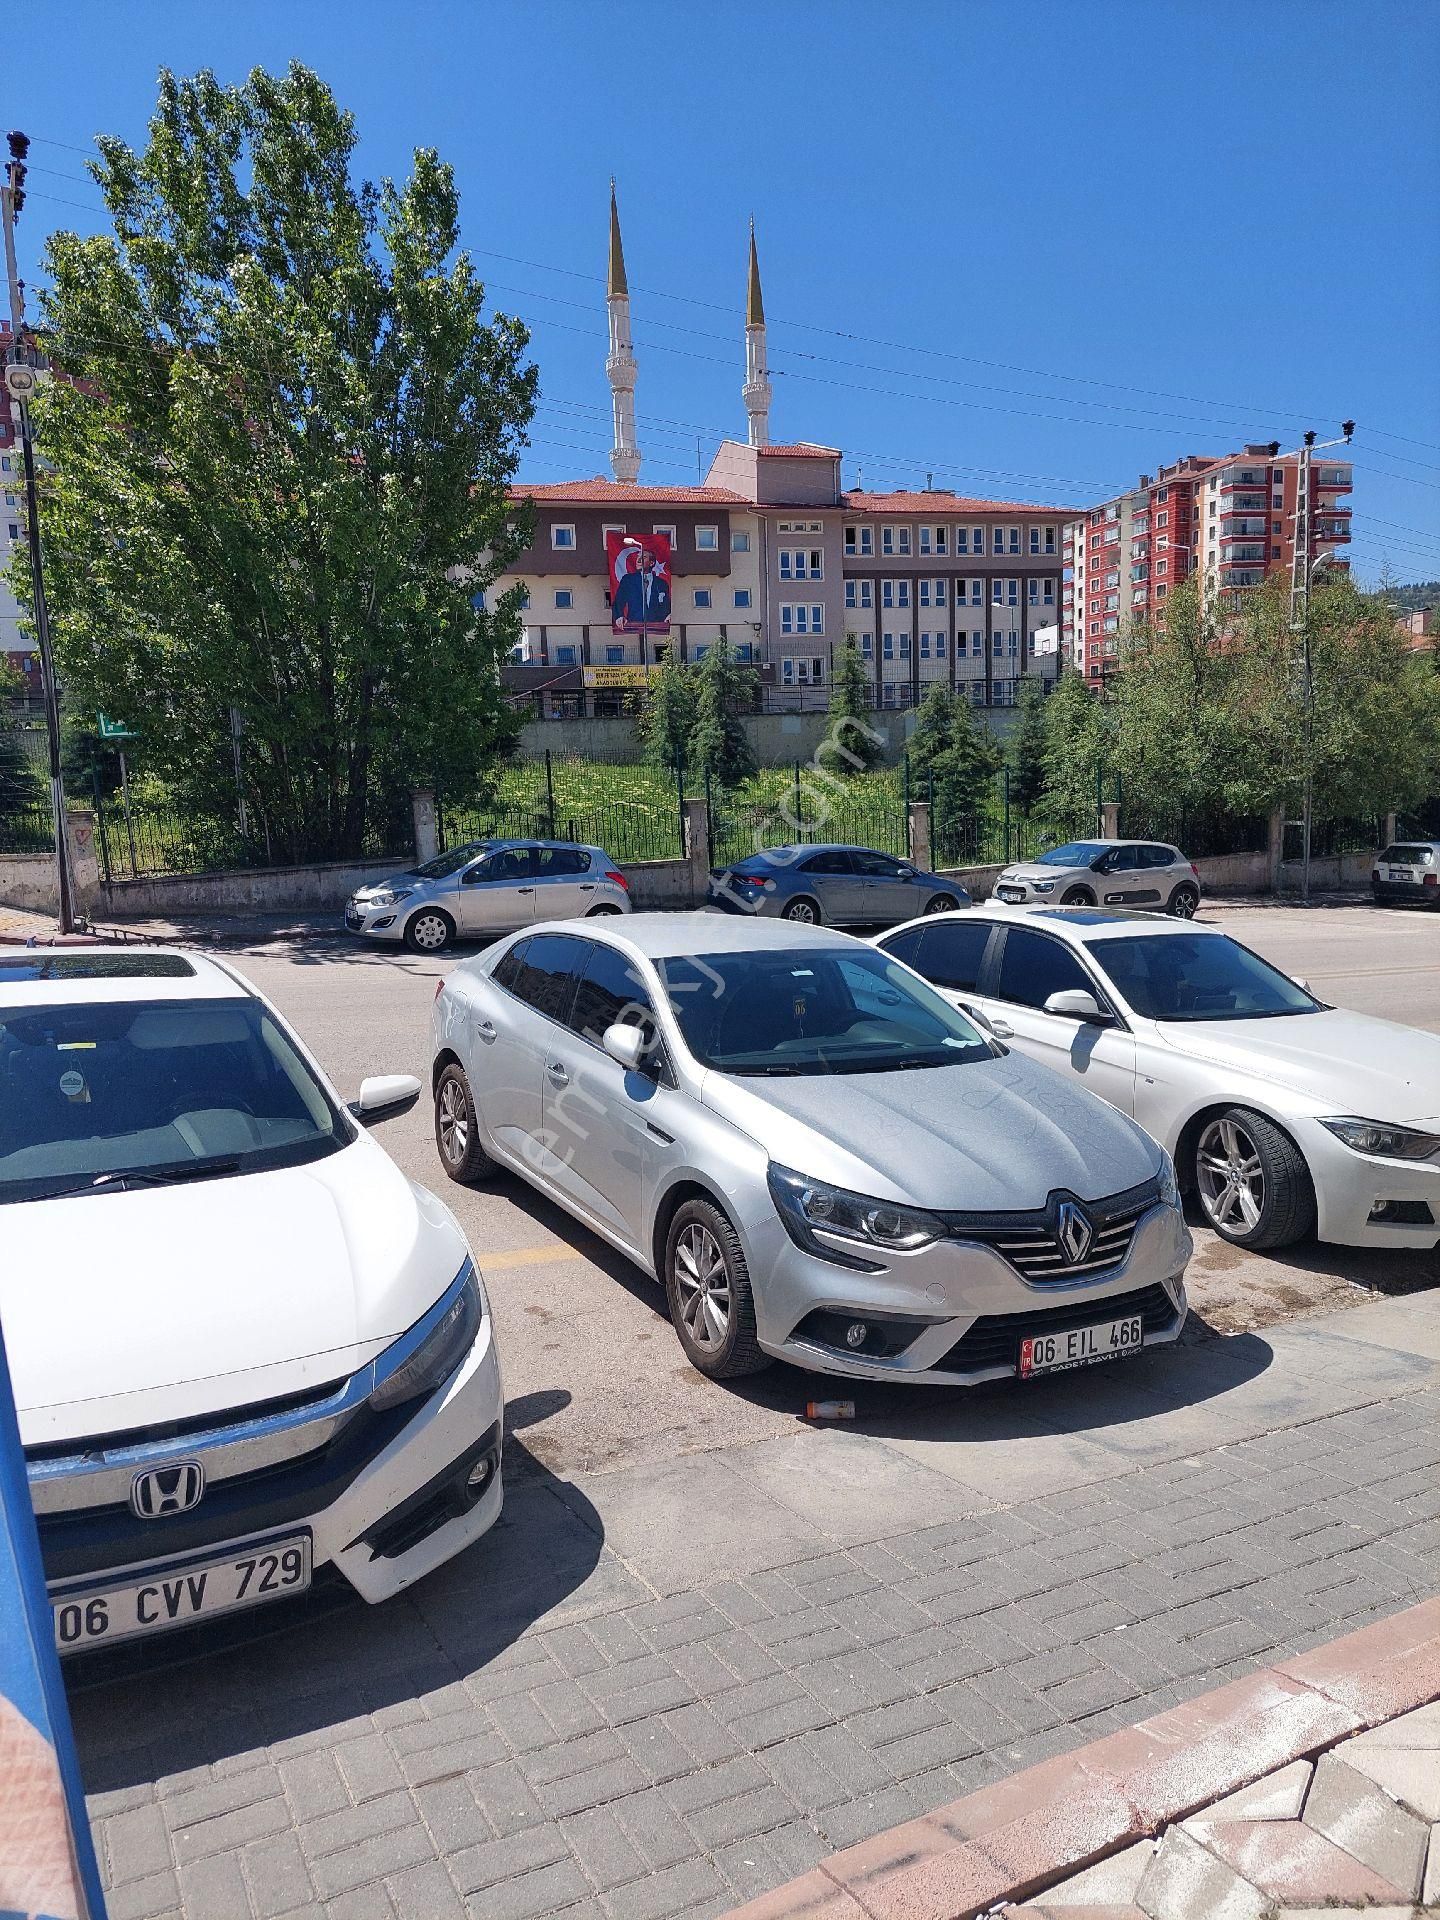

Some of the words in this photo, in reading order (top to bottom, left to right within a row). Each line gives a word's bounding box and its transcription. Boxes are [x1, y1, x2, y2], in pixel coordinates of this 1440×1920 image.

[1023, 1356, 1031, 1368] TR
[1033, 1338, 1056, 1365] 06
[1067, 1330, 1098, 1359] EIL
[1109, 1319, 1140, 1348] 466
[59, 1598, 109, 1643] 06
[137, 1572, 208, 1624] CVV
[234, 1549, 302, 1600] 729
